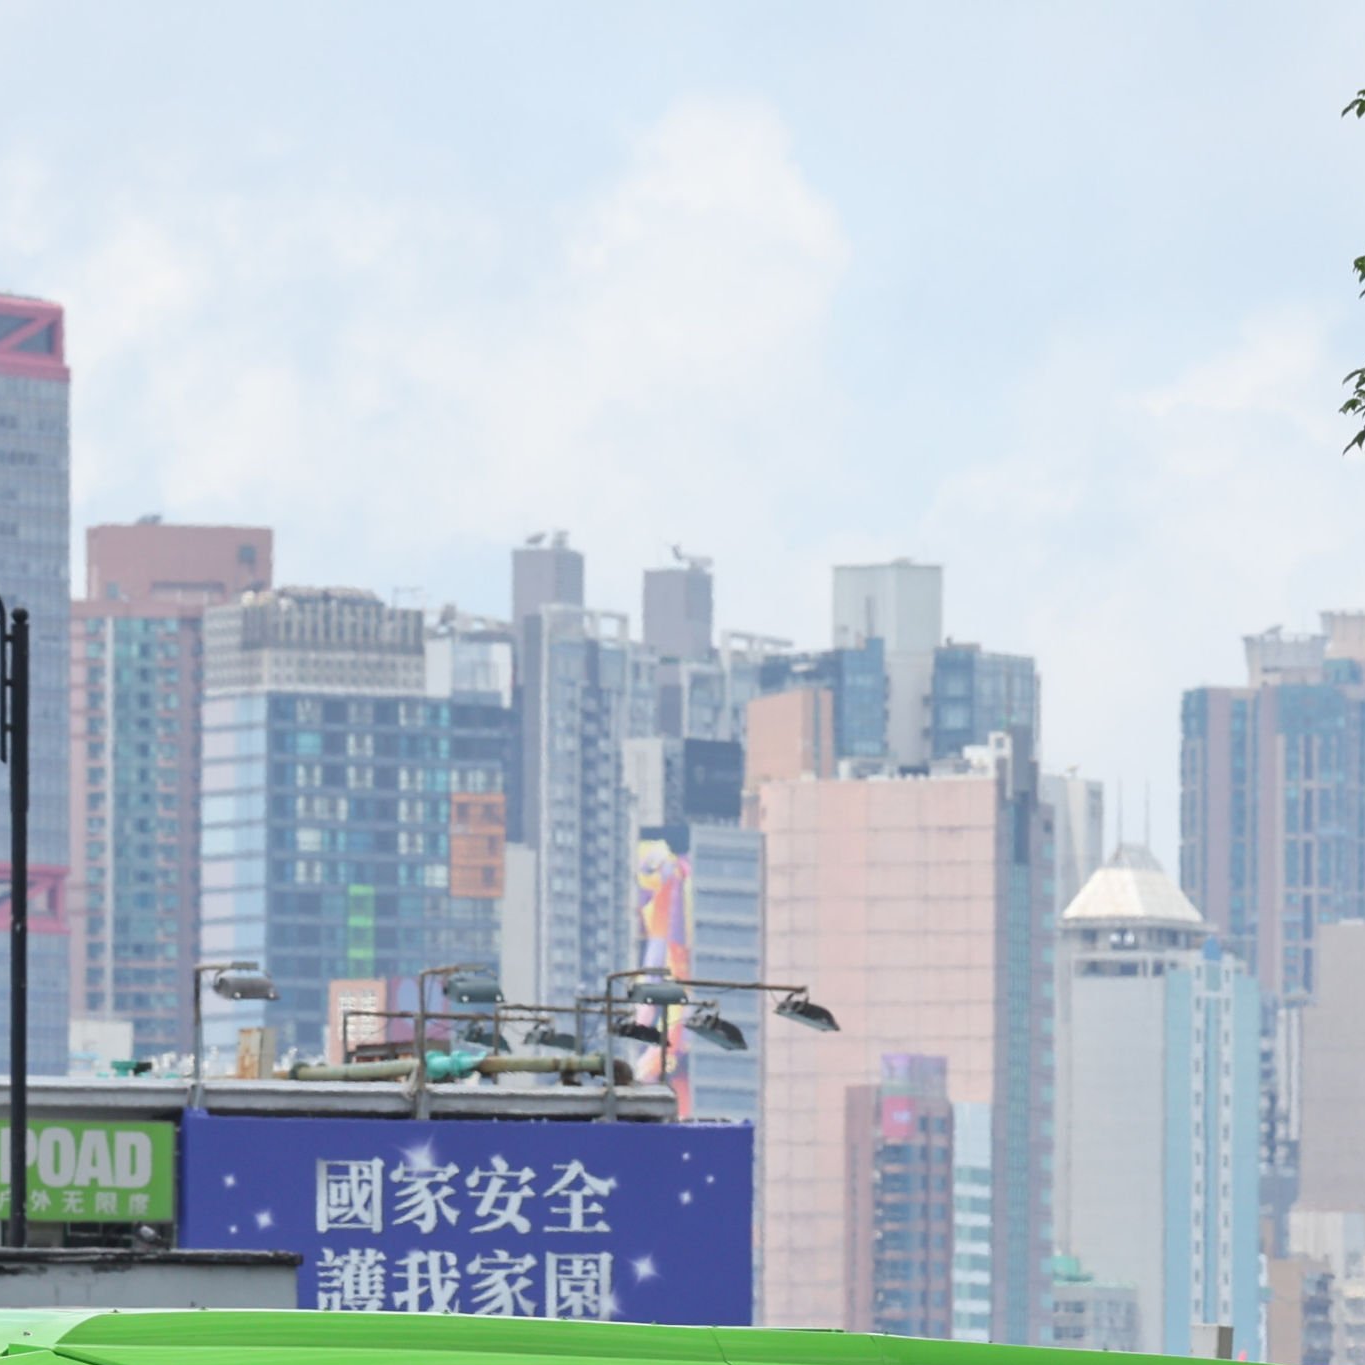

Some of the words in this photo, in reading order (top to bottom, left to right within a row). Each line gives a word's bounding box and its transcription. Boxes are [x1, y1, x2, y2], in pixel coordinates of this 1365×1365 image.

[0, 1127, 152, 1188] POAD
[316, 1157, 617, 1234] 國家安全
[317, 1247, 615, 1320] 護我家園
